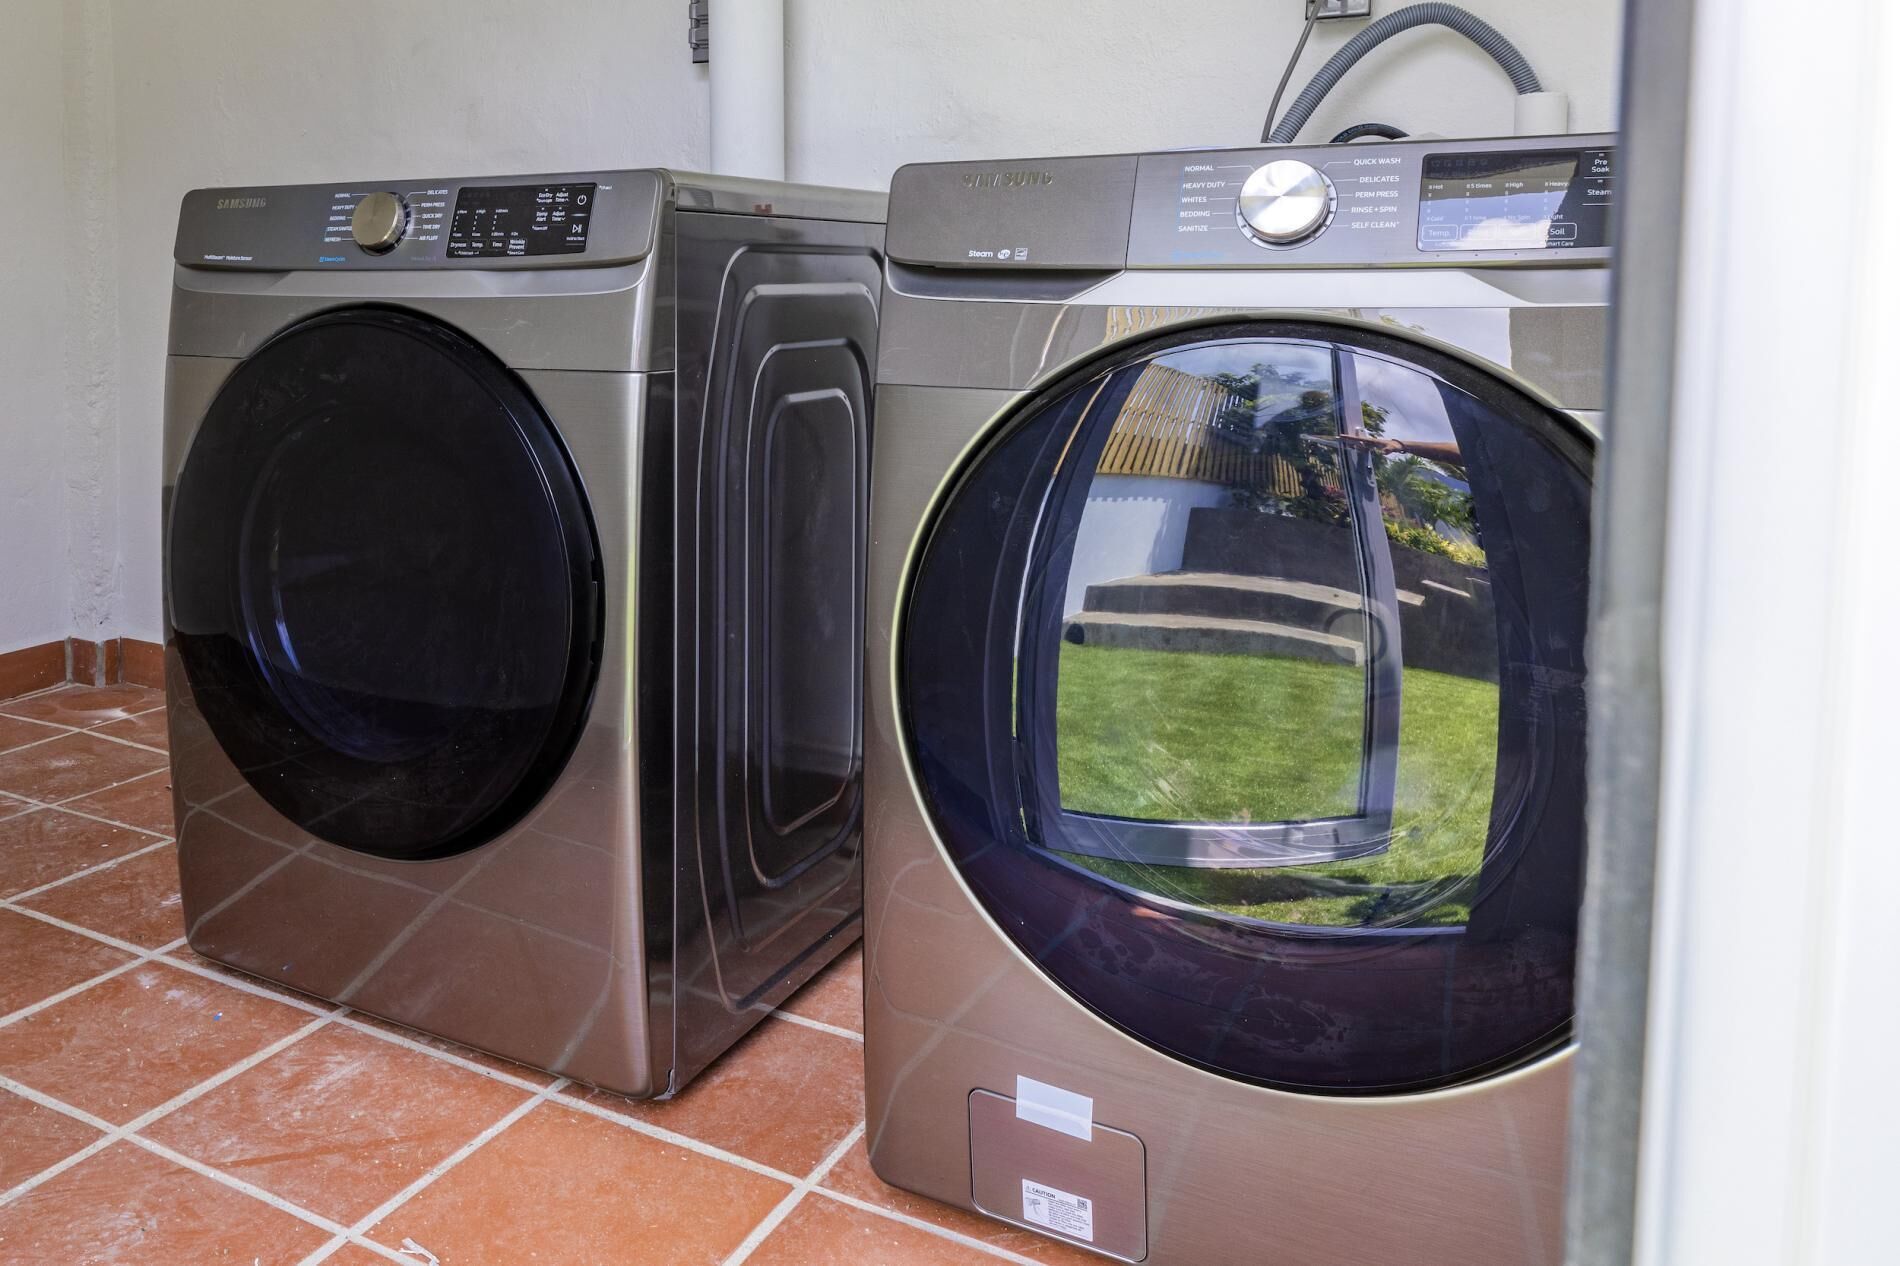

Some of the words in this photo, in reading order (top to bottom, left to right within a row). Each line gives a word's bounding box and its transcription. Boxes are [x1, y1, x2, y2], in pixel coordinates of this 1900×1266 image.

[1184, 164, 1214, 172] NORMAL
[1359, 175, 1400, 183] DELICATES
[217, 198, 266, 209] SAMSUNG
[1180, 210, 1210, 218] BEDDING
[1178, 224, 1208, 232] SANITIZE
[968, 249, 993, 257] Steam
[1032, 1187, 1056, 1199] CAUTION
